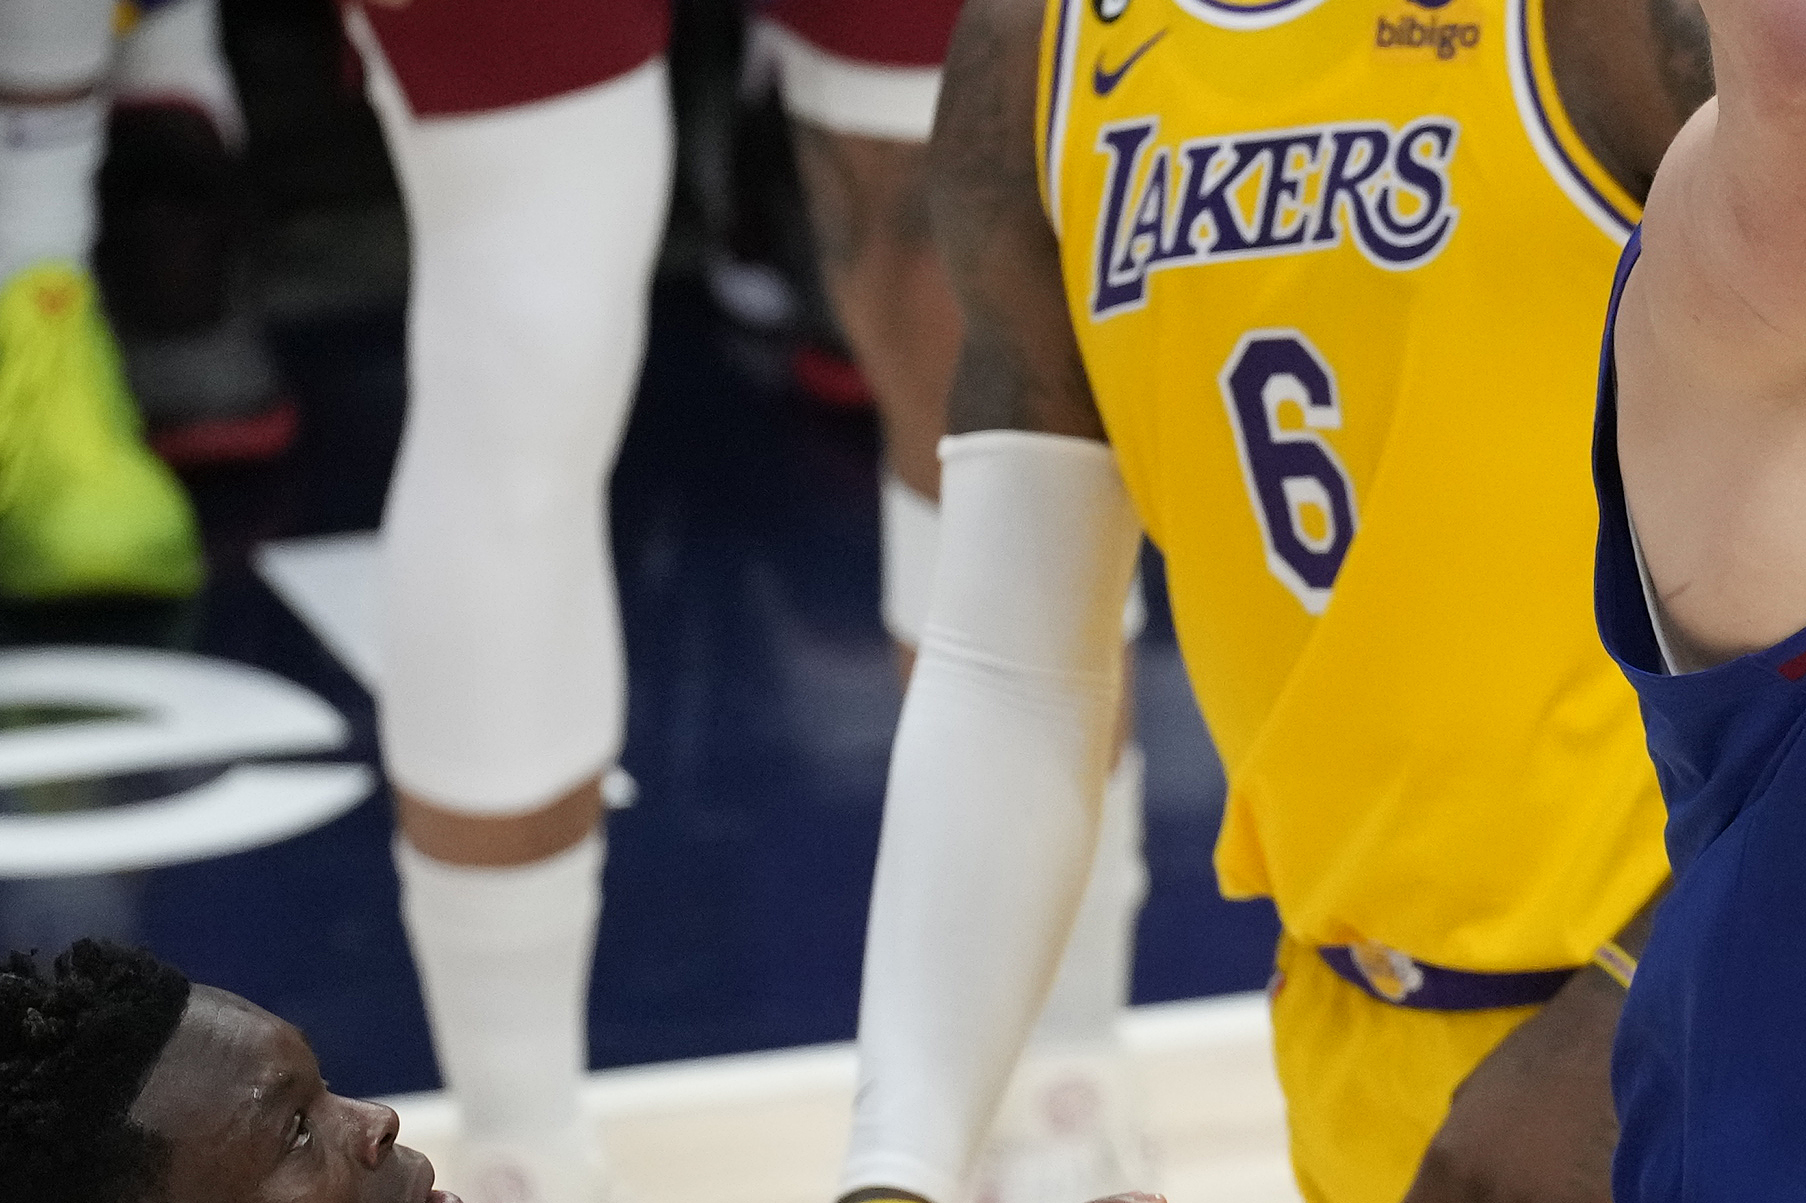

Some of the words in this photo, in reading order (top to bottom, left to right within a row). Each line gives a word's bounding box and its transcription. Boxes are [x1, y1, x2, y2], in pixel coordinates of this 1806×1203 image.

[1377, 15, 1480, 60] bibigo
[1090, 116, 1460, 323] LAKERS
[1218, 329, 1360, 616] 6
